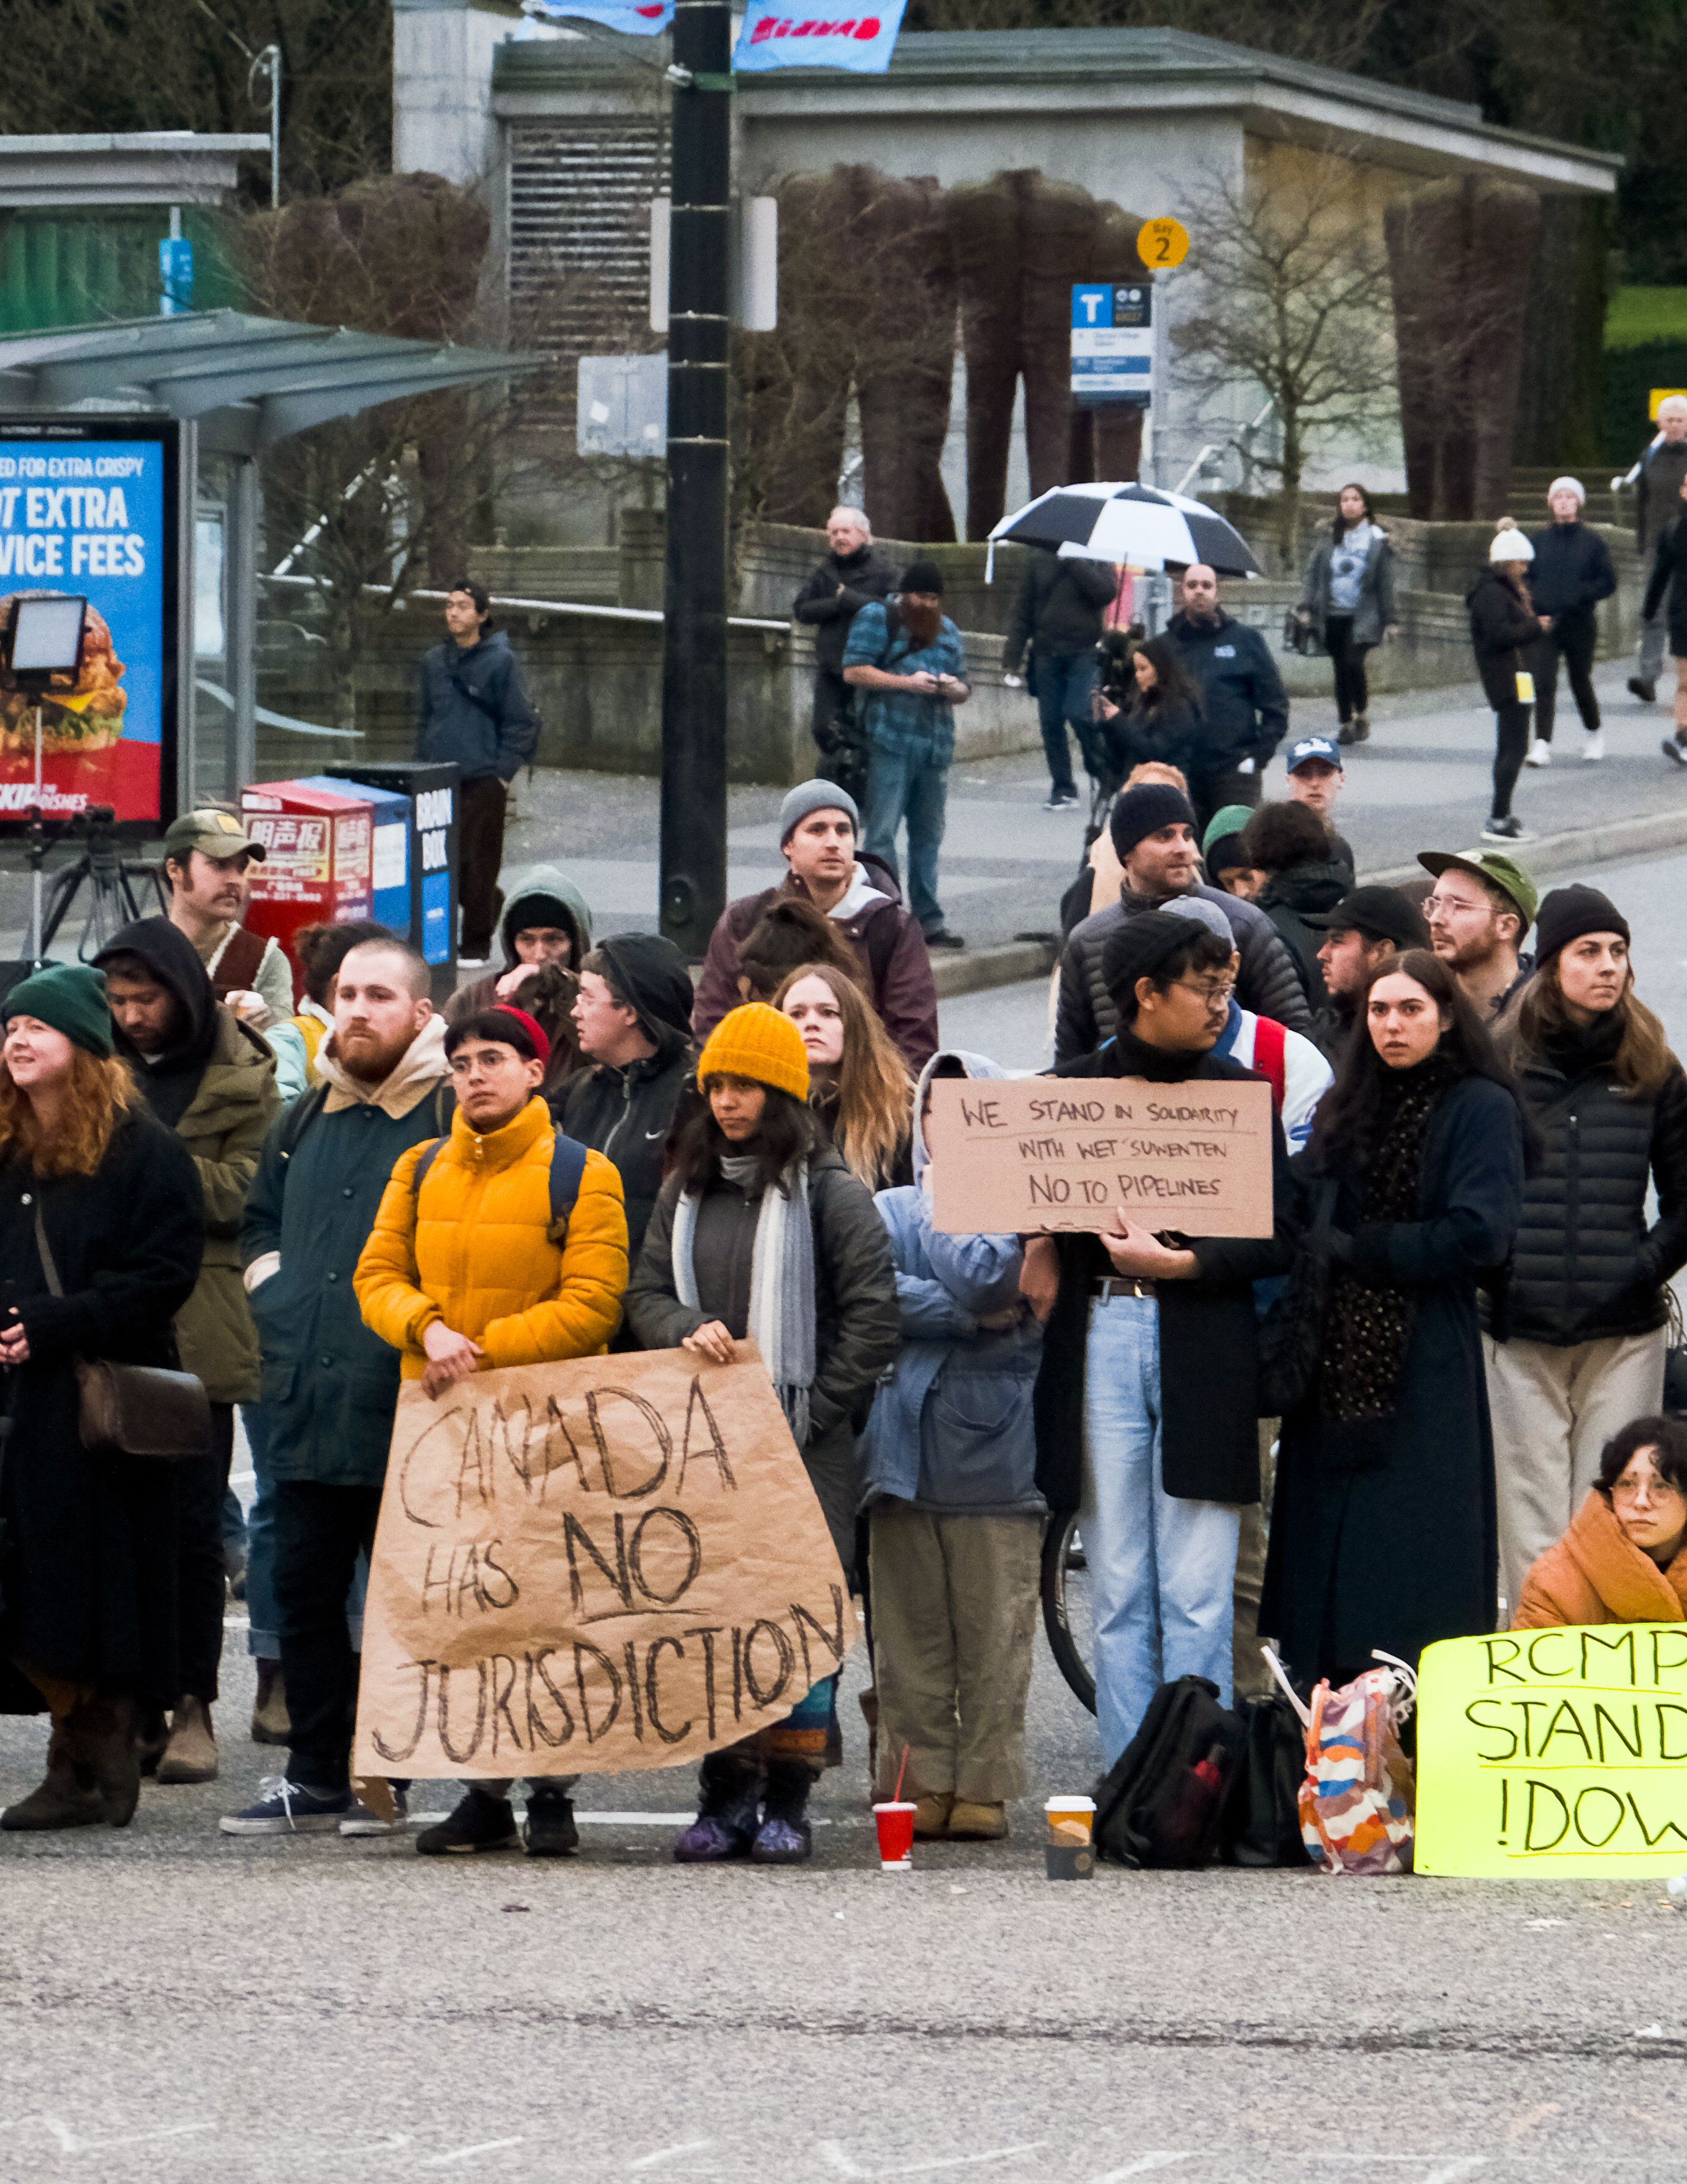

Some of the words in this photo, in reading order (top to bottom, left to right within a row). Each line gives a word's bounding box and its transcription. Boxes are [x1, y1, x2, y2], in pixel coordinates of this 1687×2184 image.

[1155, 237, 1170, 261] 2
[1080, 294, 1104, 323] T
[18, 456, 47, 478] FOR
[48, 456, 92, 478] EXTRA
[94, 456, 145, 478] CRISPY
[0, 487, 22, 528] T
[26, 487, 129, 528] EXTRA
[71, 533, 146, 577] FEES
[961, 1098, 1008, 1127] WE
[1028, 1099, 1105, 1122] STAND
[1115, 1103, 1133, 1120] IN
[1019, 1138, 1066, 1160] WITH
[1029, 1174, 1071, 1204] NO
[1076, 1179, 1108, 1204] TO
[1117, 1173, 1221, 1199] PIPELINES
[399, 1373, 739, 1528] CANADA
[421, 1540, 520, 1618] HAS
[562, 1506, 702, 1613] NO
[372, 1583, 844, 1762] JURISDICTION
[1477, 1630, 1687, 1686] RCMP
[1465, 1699, 1687, 1763] STAND
